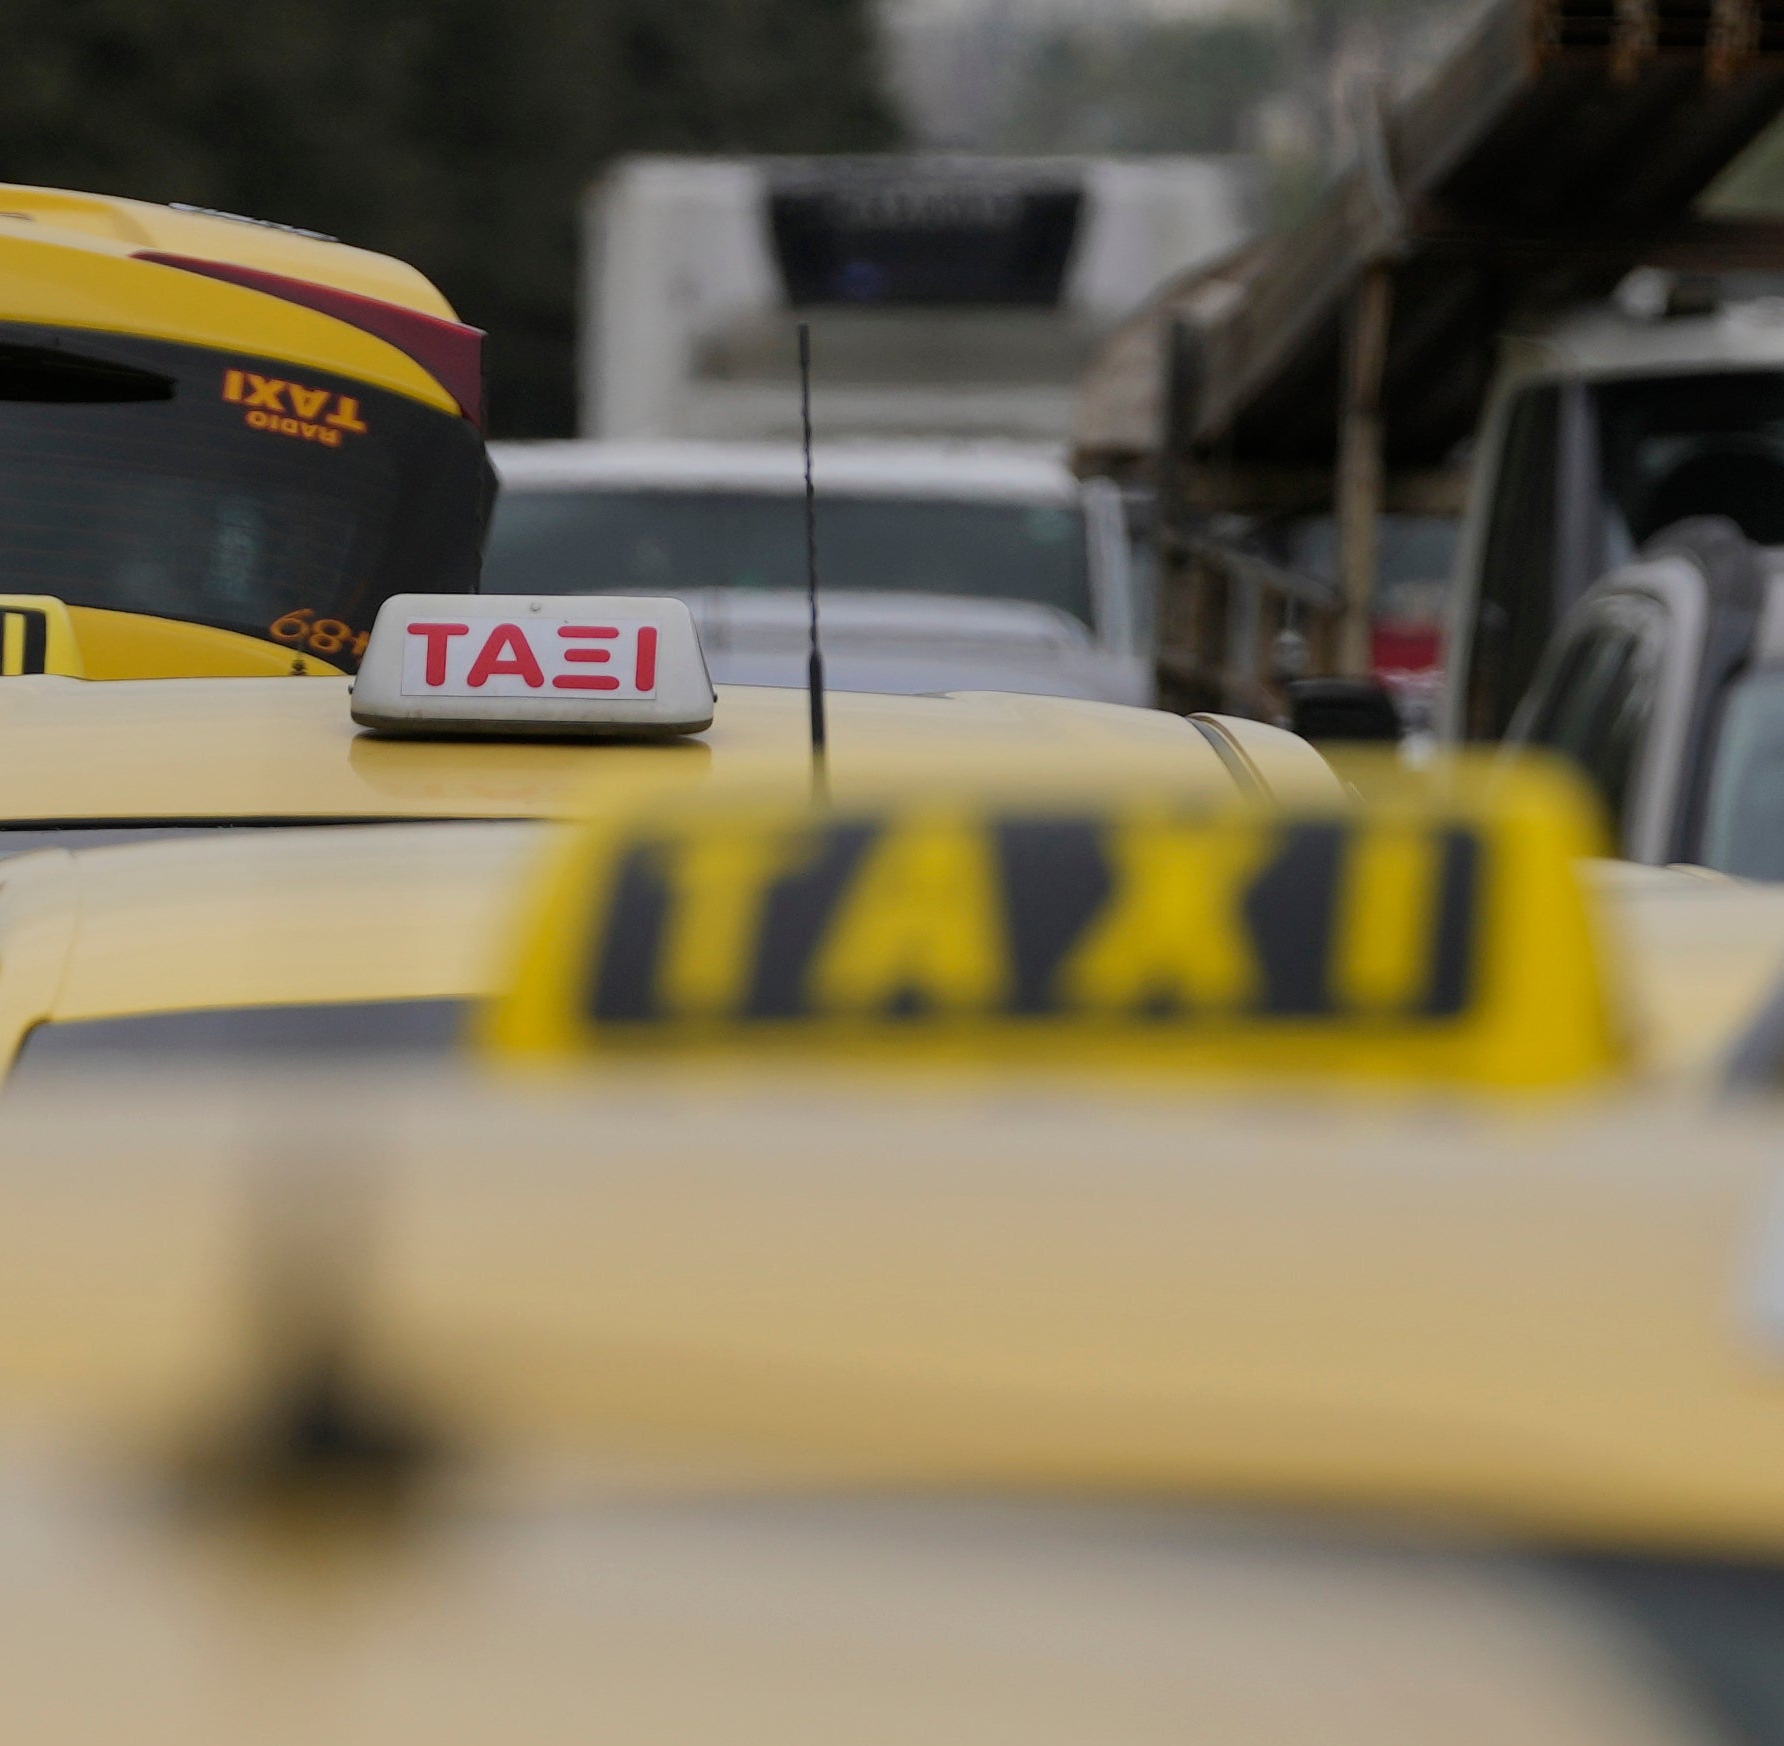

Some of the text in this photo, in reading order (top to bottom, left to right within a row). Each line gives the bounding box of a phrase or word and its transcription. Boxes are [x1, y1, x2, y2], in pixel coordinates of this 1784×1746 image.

[222, 369, 368, 433] TAXI
[245, 410, 342, 447] RADIO
[407, 622, 658, 692] ΤΑΞΙ
[631, 812, 1431, 1006] TAXI
